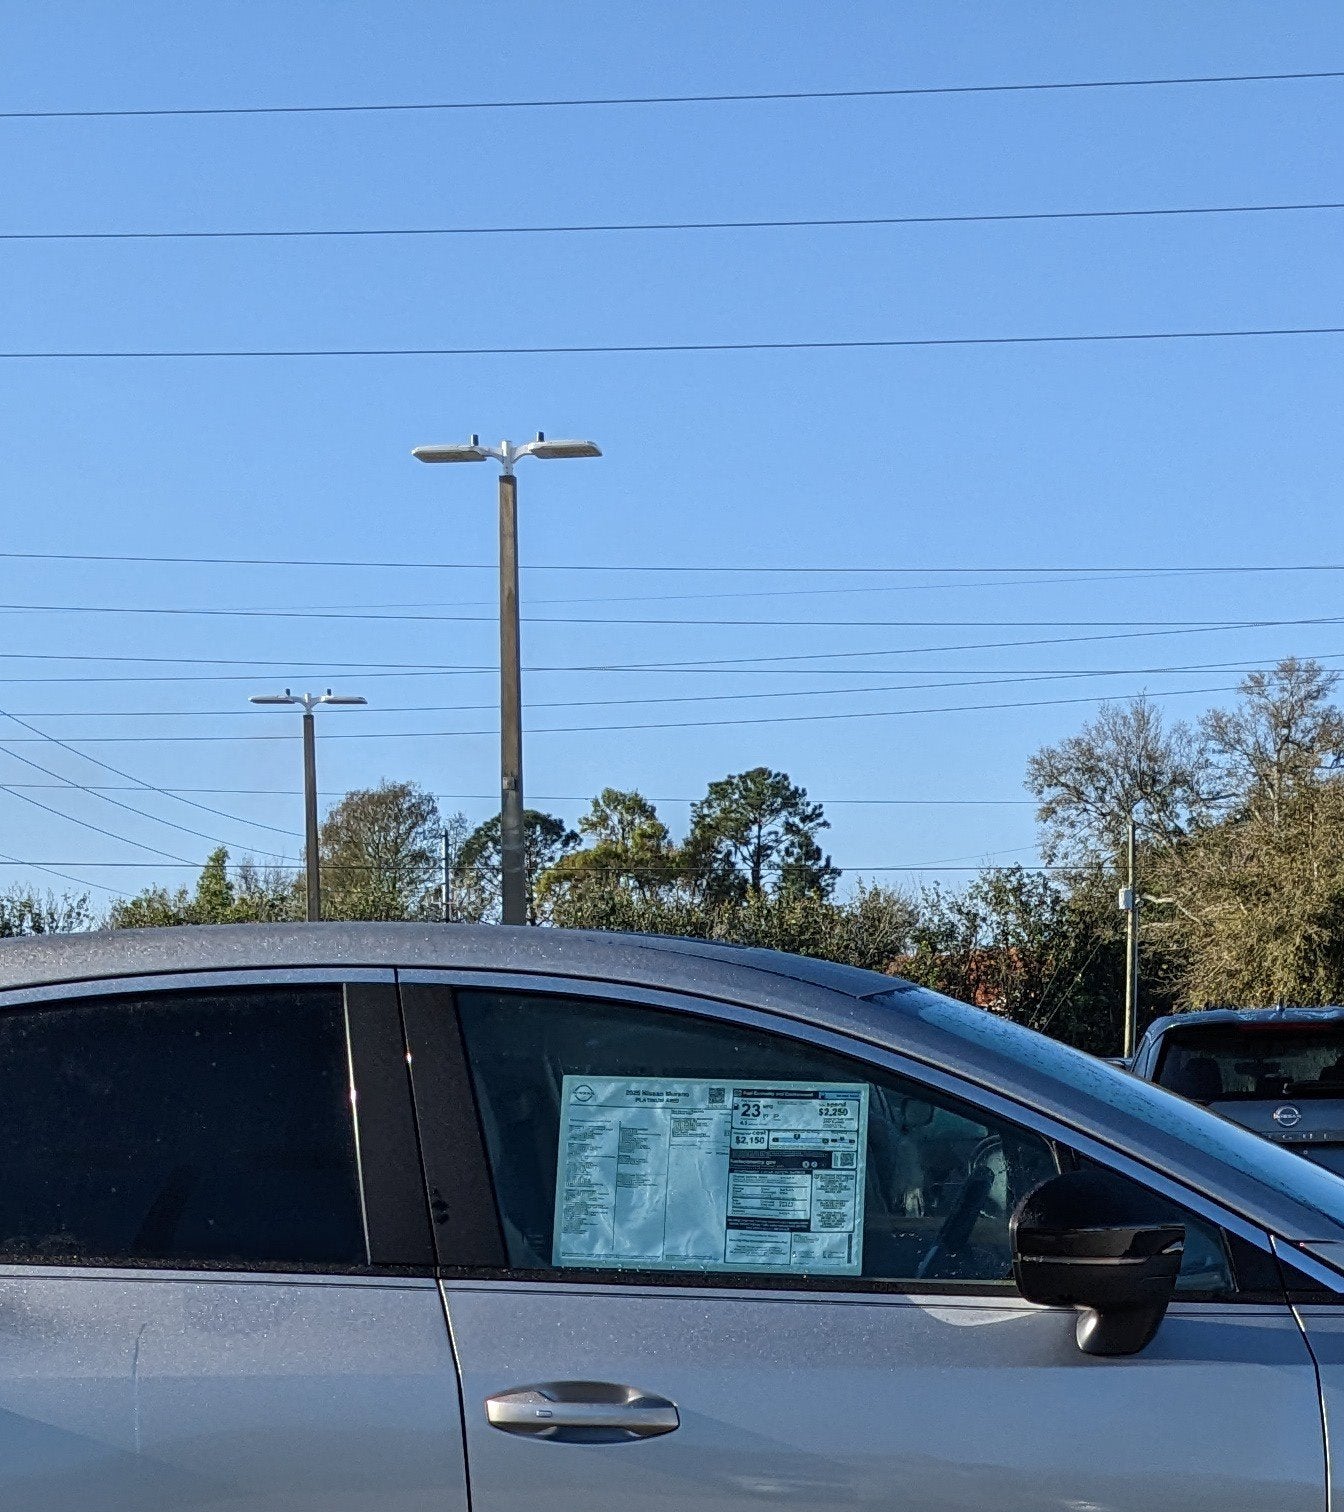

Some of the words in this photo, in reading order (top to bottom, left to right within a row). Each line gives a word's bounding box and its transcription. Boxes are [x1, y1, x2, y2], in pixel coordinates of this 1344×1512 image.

[740, 1103, 761, 1118] 23
[818, 1108, 849, 1117] $2,250
[735, 1135, 765, 1145] $2,150
